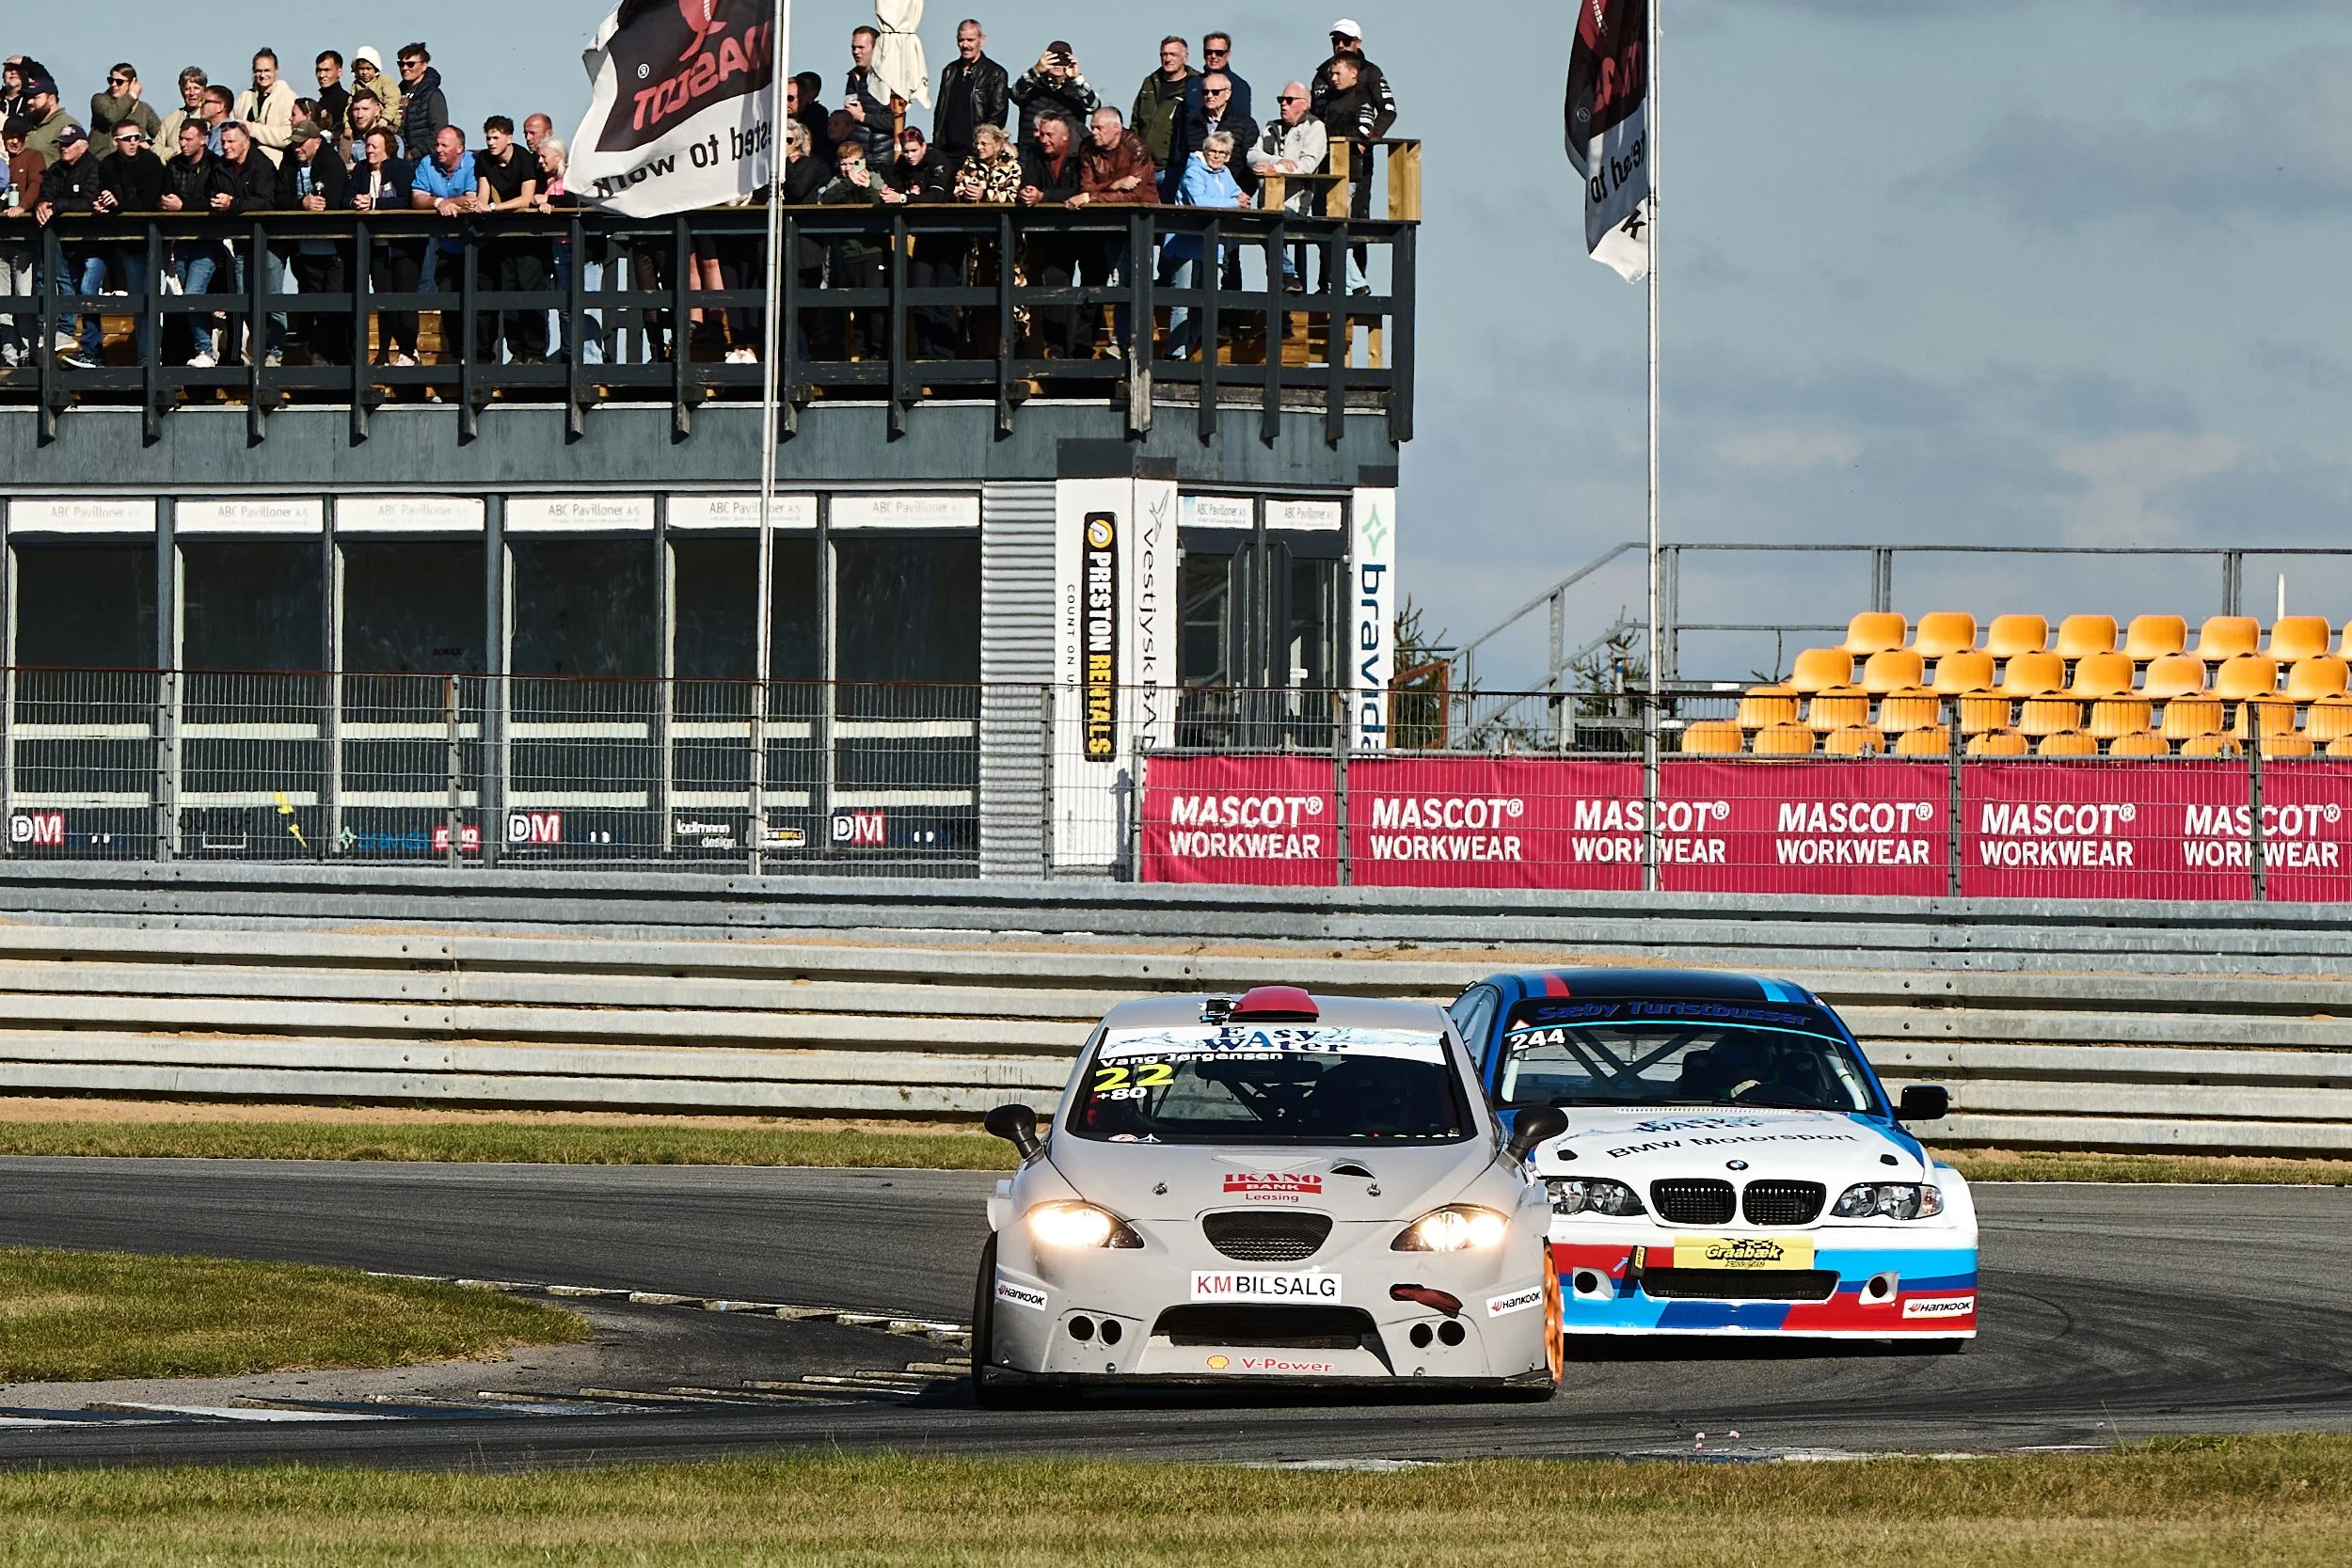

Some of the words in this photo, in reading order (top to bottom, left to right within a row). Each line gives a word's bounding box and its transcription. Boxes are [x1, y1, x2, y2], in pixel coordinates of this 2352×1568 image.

[548, 503, 567, 515] ABC
[709, 501, 730, 514] ABC
[733, 501, 784, 514] Pavillner
[1067, 584, 1075, 637] COUNT
[1089, 551, 1112, 652] PRESTON
[1139, 528, 1156, 673] Vestjysk
[1067, 645, 1075, 665] ON
[1089, 655, 1112, 754] RENTALS
[11, 815, 63, 844] DM
[509, 814, 560, 843] DM
[833, 815, 883, 843] DM
[1169, 831, 1320, 859] WORKWEAR
[1370, 834, 1521, 862] WORKWEAR
[1776, 838, 1930, 864] WORKWEAR
[1979, 840, 2134, 866] WORKWEAR
[1536, 1002, 1620, 1020] Sæby
[1629, 1001, 1812, 1025] Turistbusser
[1511, 1028, 1565, 1052] 244
[1101, 1054, 1158, 1068] Vang
[1165, 1052, 1283, 1062] Jørgensen
[1094, 1064, 1174, 1092] 22
[1096, 1086, 1148, 1101] +80
[1607, 1138, 1682, 1159] BMW
[1690, 1132, 1860, 1147] Motorsport
[1225, 1174, 1323, 1184] IKANO
[1246, 1194, 1299, 1203] Leasing
[1706, 1243, 1783, 1261] Graabæk
[1242, 1357, 1332, 1371] V-Power
